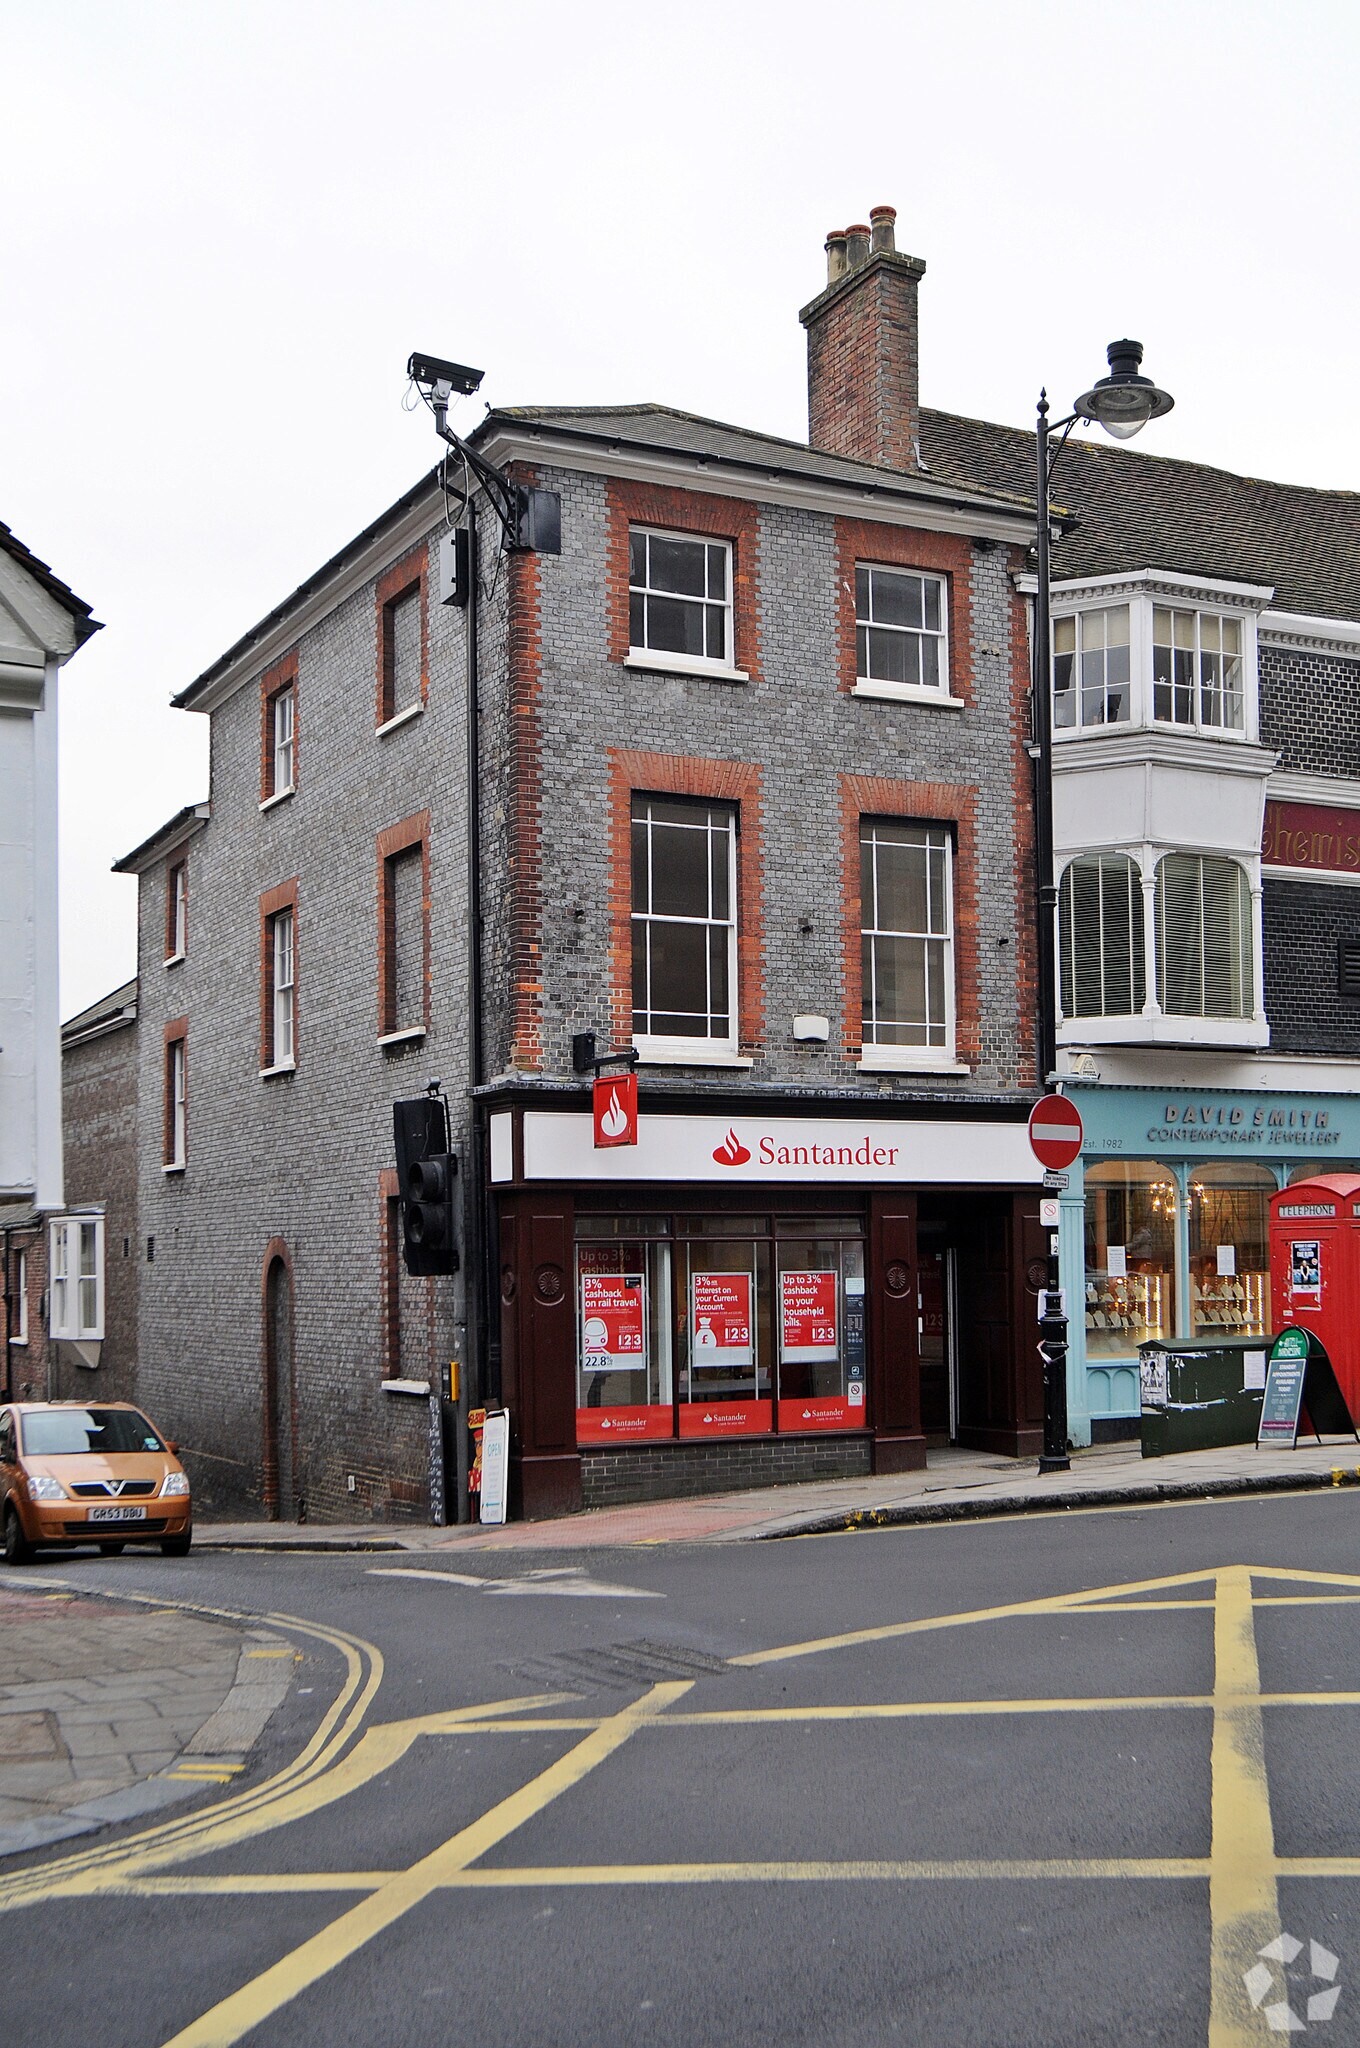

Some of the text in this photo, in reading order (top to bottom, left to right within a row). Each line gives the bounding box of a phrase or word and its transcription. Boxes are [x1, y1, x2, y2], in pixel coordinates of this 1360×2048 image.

[1165, 1105, 1331, 1129] DAVID SMITH
[1146, 1126, 1342, 1146] CONTEMPORARY JEWELLERY
[1083, 1138, 1123, 1149] Est. 1982
[759, 1136, 899, 1166] Santander
[1281, 1205, 1334, 1216] TELEPHONE
[581, 1249, 632, 1264] Up to 3%
[585, 1278, 603, 1290] 3%
[695, 1276, 711, 1286] 3%
[783, 1274, 822, 1286] Up to 3%
[585, 1288, 622, 1299] cashback
[695, 1286, 721, 1294] interest
[783, 1285, 818, 1295] cashback
[585, 1297, 639, 1308] on rail travel.
[695, 1294, 738, 1304] your Current
[795, 1298, 814, 1307] your
[695, 1303, 725, 1311] Account.
[784, 1306, 824, 1317] household
[784, 1316, 802, 1327] bills.
[713, 1413, 747, 1423] Santander
[812, 1408, 844, 1418] Santander
[612, 1417, 647, 1427] Santander
[93, 1508, 120, 1519] GR53
